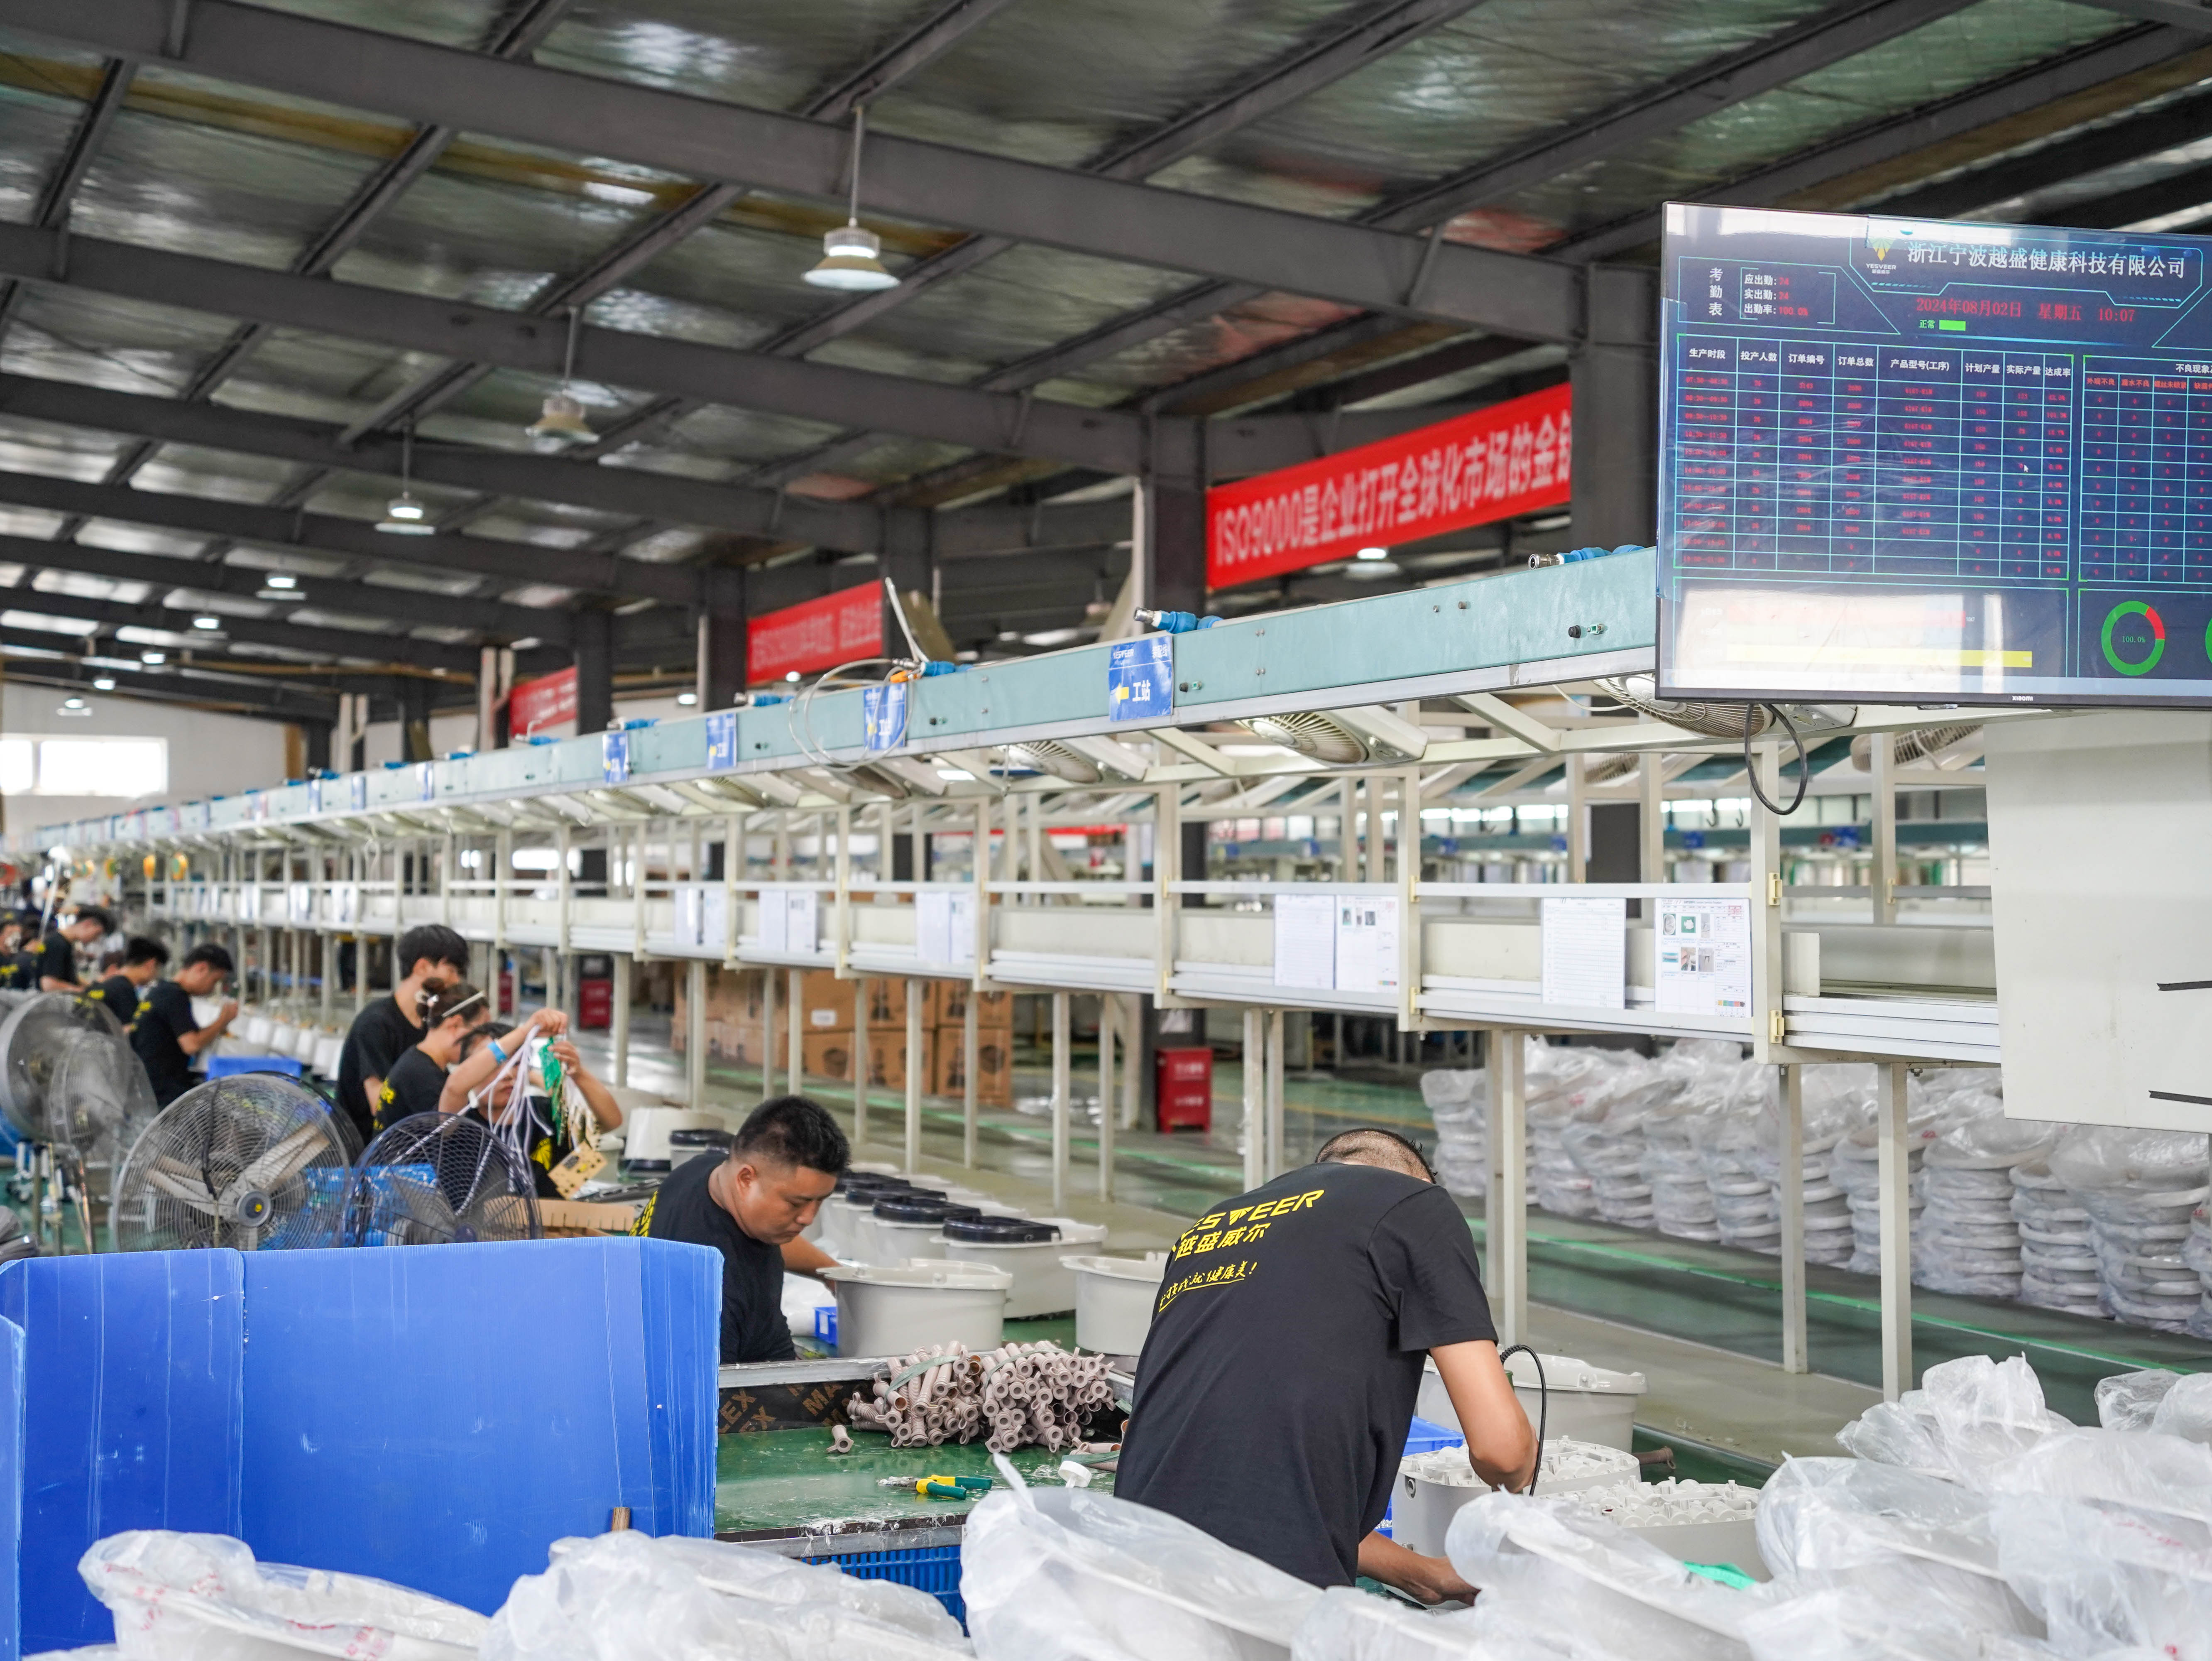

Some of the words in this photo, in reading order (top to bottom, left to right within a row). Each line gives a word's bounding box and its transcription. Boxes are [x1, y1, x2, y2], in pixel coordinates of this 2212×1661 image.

[1907, 242, 2185, 279] 浙江宁波越盛健康科技有限公司
[1708, 267, 1723, 316] 考勤表
[1744, 274, 1777, 286] 应出勤:
[1744, 288, 1776, 300] 实出勤:
[1744, 303, 1776, 314] 出勤率:
[1779, 306, 1808, 316] 100.0%
[1916, 297, 2021, 318] 2024年08月02日
[2038, 303, 2082, 321] 星期五
[2098, 308, 2135, 322] 10:07
[1689, 348, 1726, 360] 生产时段
[1741, 351, 1777, 362] 投产人数
[1789, 353, 1825, 365] 订单编号
[1838, 356, 1874, 367] 订单总数
[1890, 359, 1950, 371] 产品型号(工序)
[1965, 363, 2000, 374] 计划产量
[2006, 365, 2041, 375] 实际产量
[2045, 367, 2071, 377] 达成率
[2176, 363, 2212, 374] 不良现象
[1132, 679, 1151, 702] 工站
[1175, 1223, 1271, 1262] 越盛威尔
